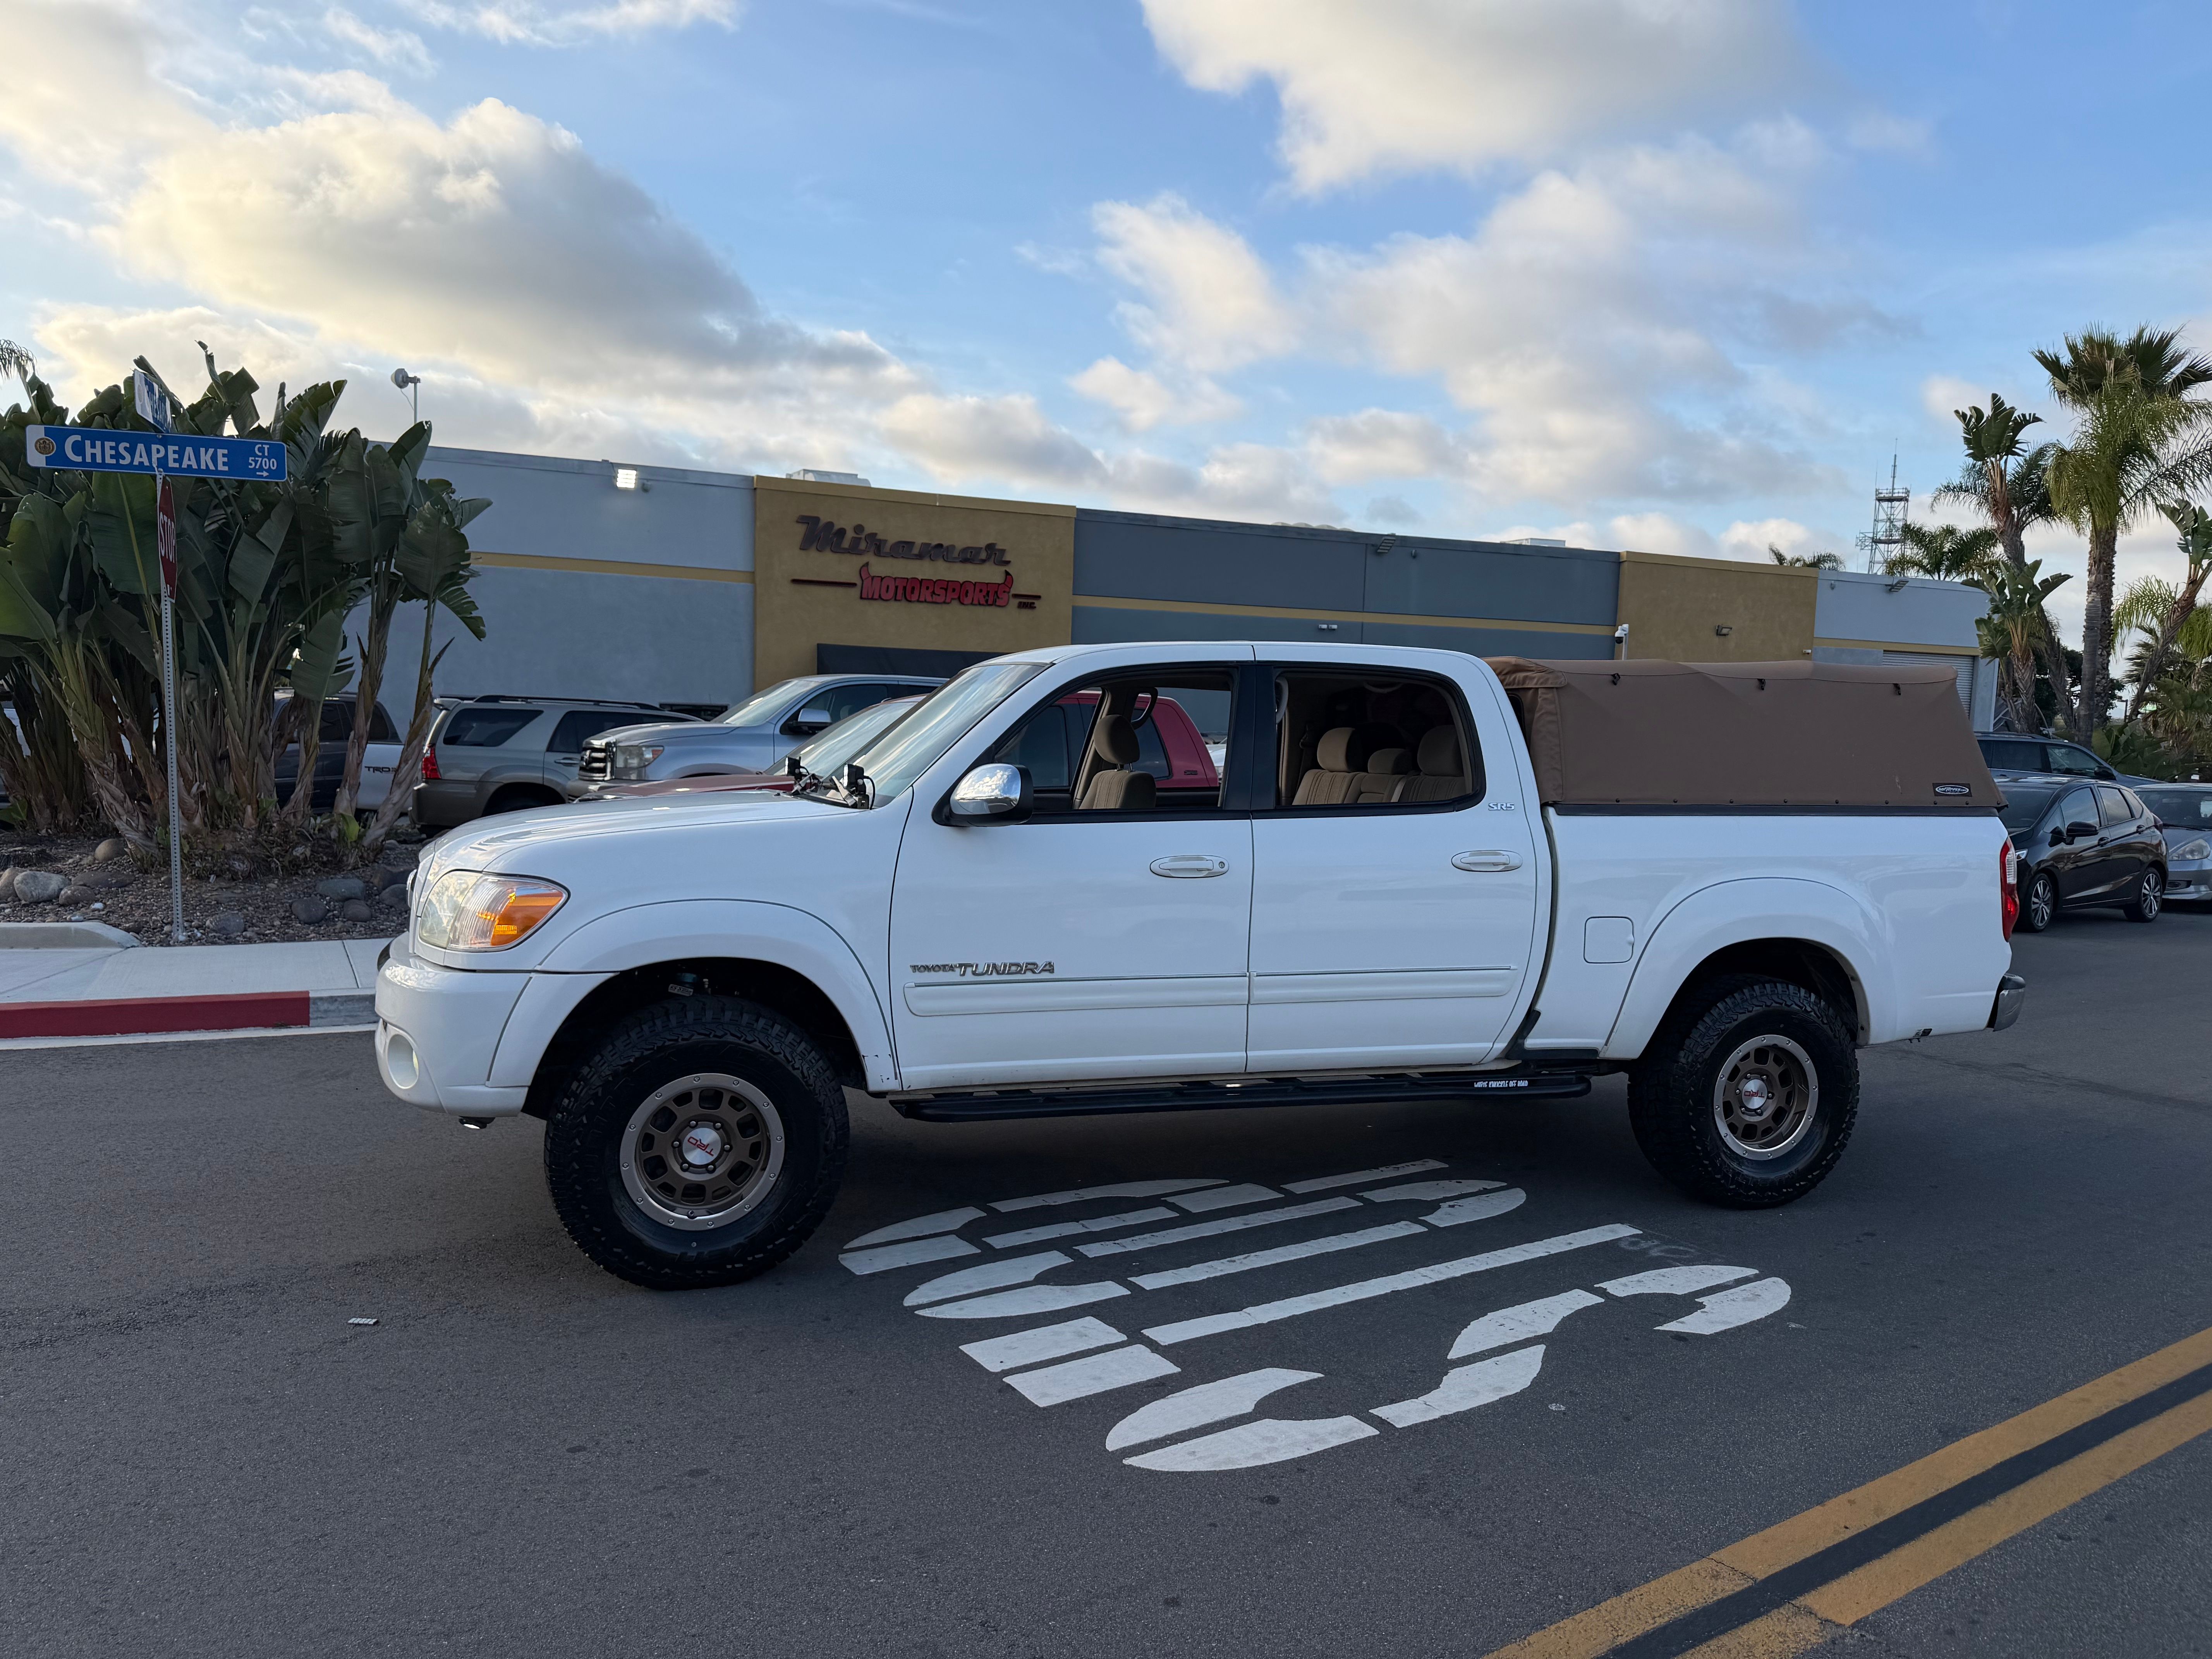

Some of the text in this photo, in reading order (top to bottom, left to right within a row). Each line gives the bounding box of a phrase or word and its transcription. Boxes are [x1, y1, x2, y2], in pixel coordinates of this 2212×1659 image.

[64, 434, 229, 471] CHESAPEAKE
[254, 444, 270, 456] CT
[248, 457, 277, 470] 5700
[160, 512, 176, 563] STOP
[796, 515, 1012, 566] Miramar
[860, 572, 1012, 607] MOTORSPORTS
[364, 766, 391, 774] TRD
[1488, 802, 1515, 811] SR5
[910, 960, 1055, 977] TOYOTA TUNDRA
[1744, 1089, 1765, 1098] TRD
[687, 1135, 714, 1157] TRD
[838, 1157, 1793, 1472] STOP
